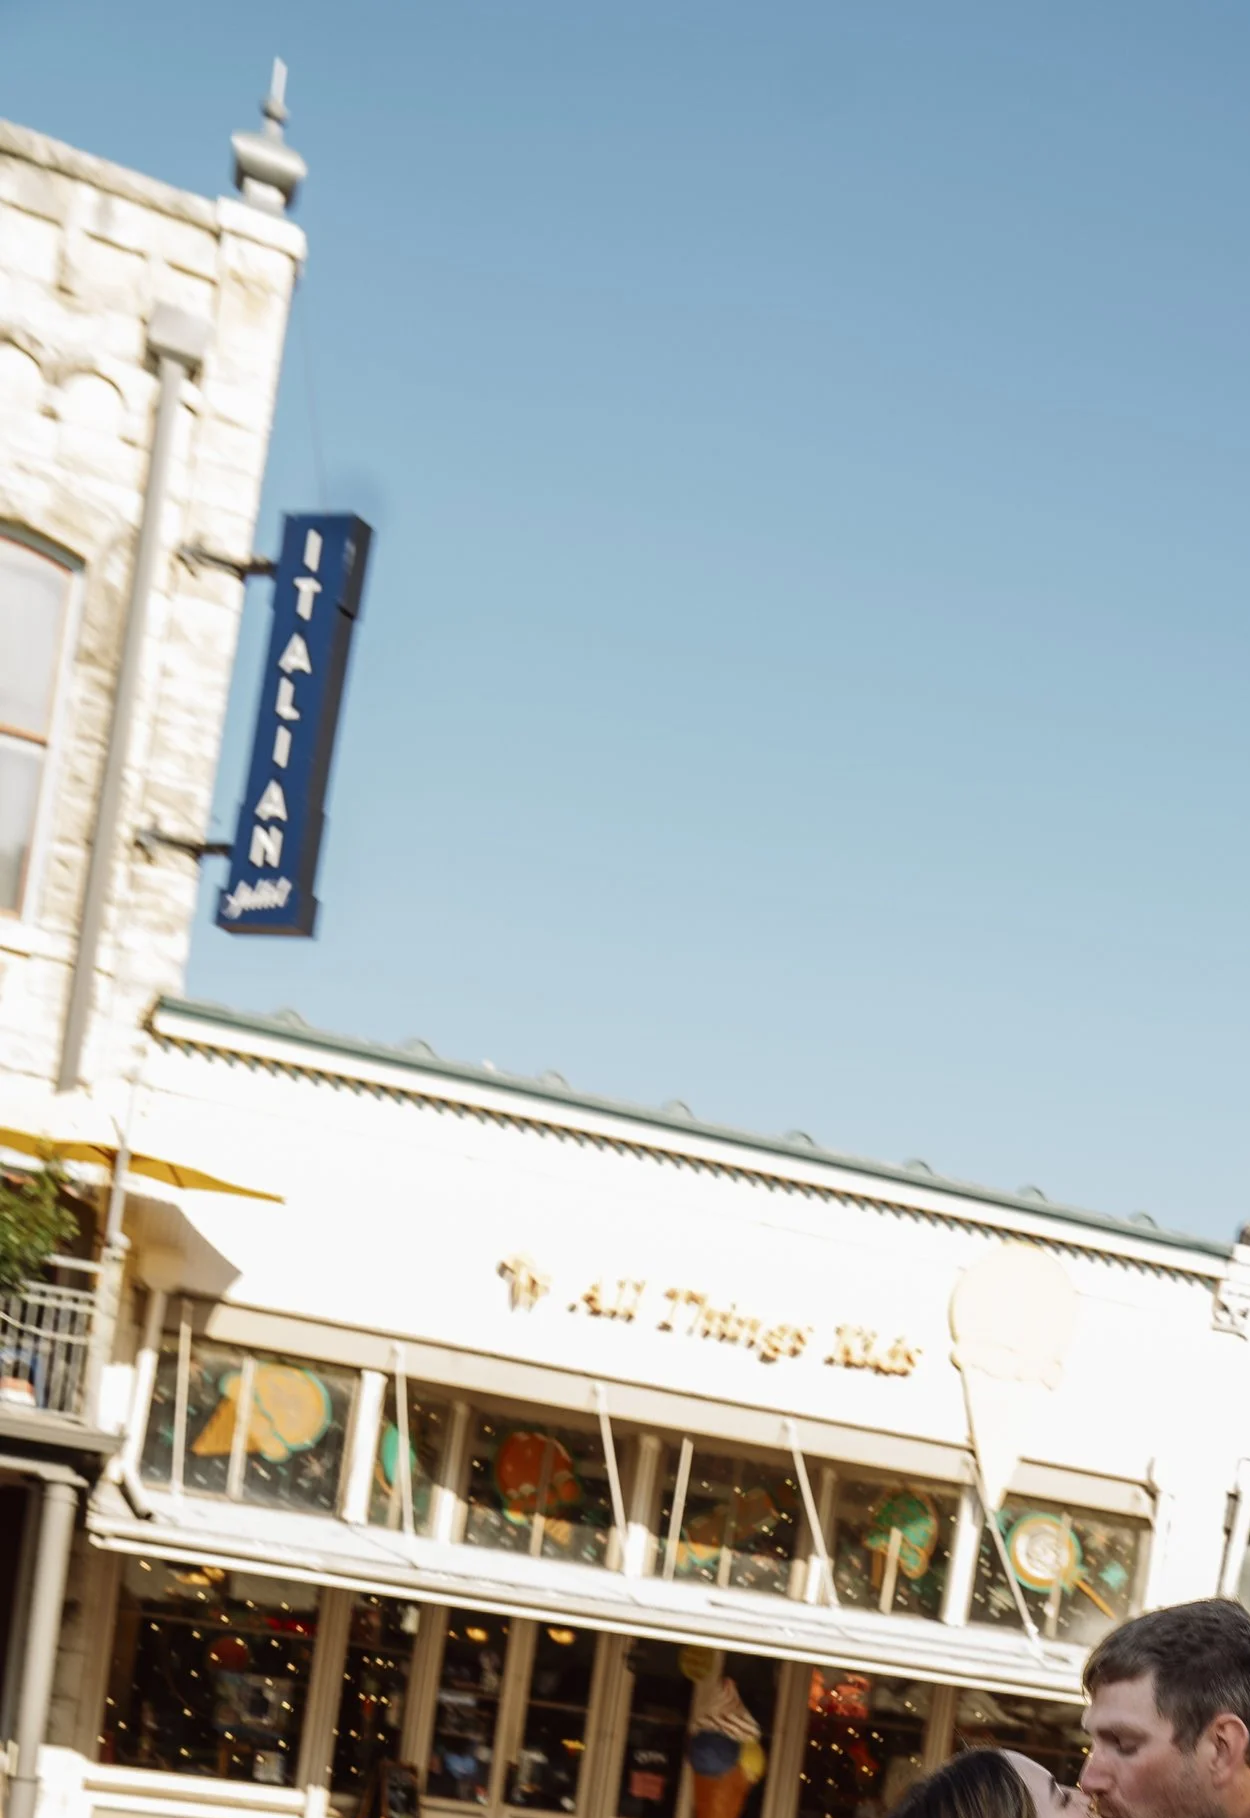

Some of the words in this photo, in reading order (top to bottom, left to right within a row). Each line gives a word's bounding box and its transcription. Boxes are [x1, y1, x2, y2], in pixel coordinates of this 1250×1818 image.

[249, 528, 323, 868] ITALIAN
[566, 1278, 647, 1324] All
[656, 1286, 814, 1365] Things
